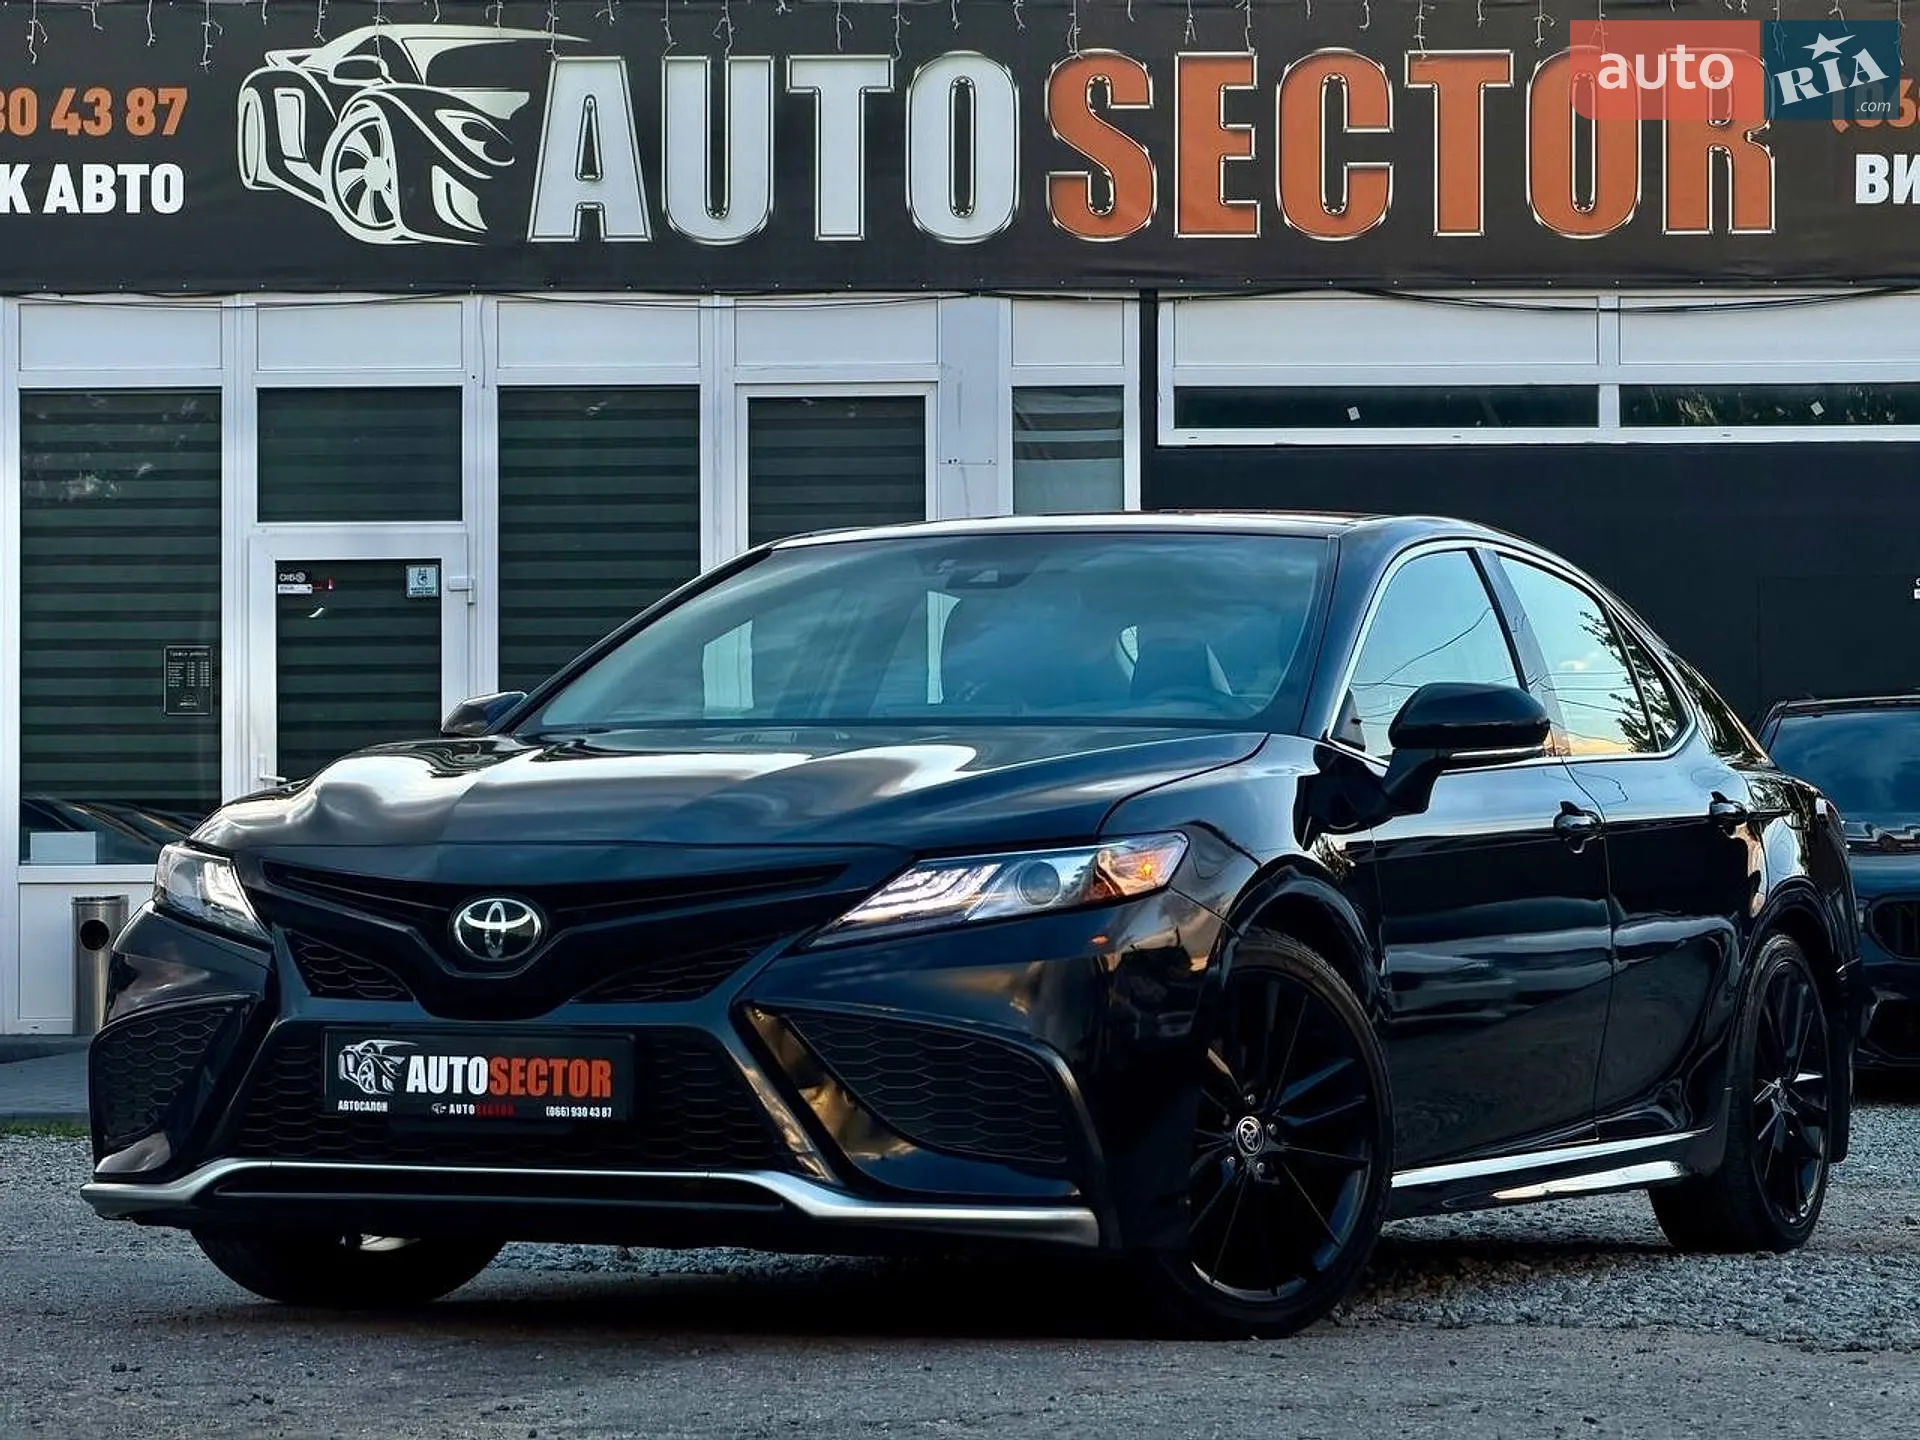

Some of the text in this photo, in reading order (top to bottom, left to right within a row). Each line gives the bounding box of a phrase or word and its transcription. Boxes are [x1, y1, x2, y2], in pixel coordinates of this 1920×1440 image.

[51, 87, 113, 136] 43
[125, 87, 188, 136] 87
[42, 163, 184, 214] АВТО
[406, 1055, 612, 1098] AUTOSECTOR
[337, 1100, 388, 1112] АВТОСАЛОН
[571, 1106, 588, 1118] 930
[589, 1107, 601, 1118] 43
[602, 1107, 612, 1118] 87
